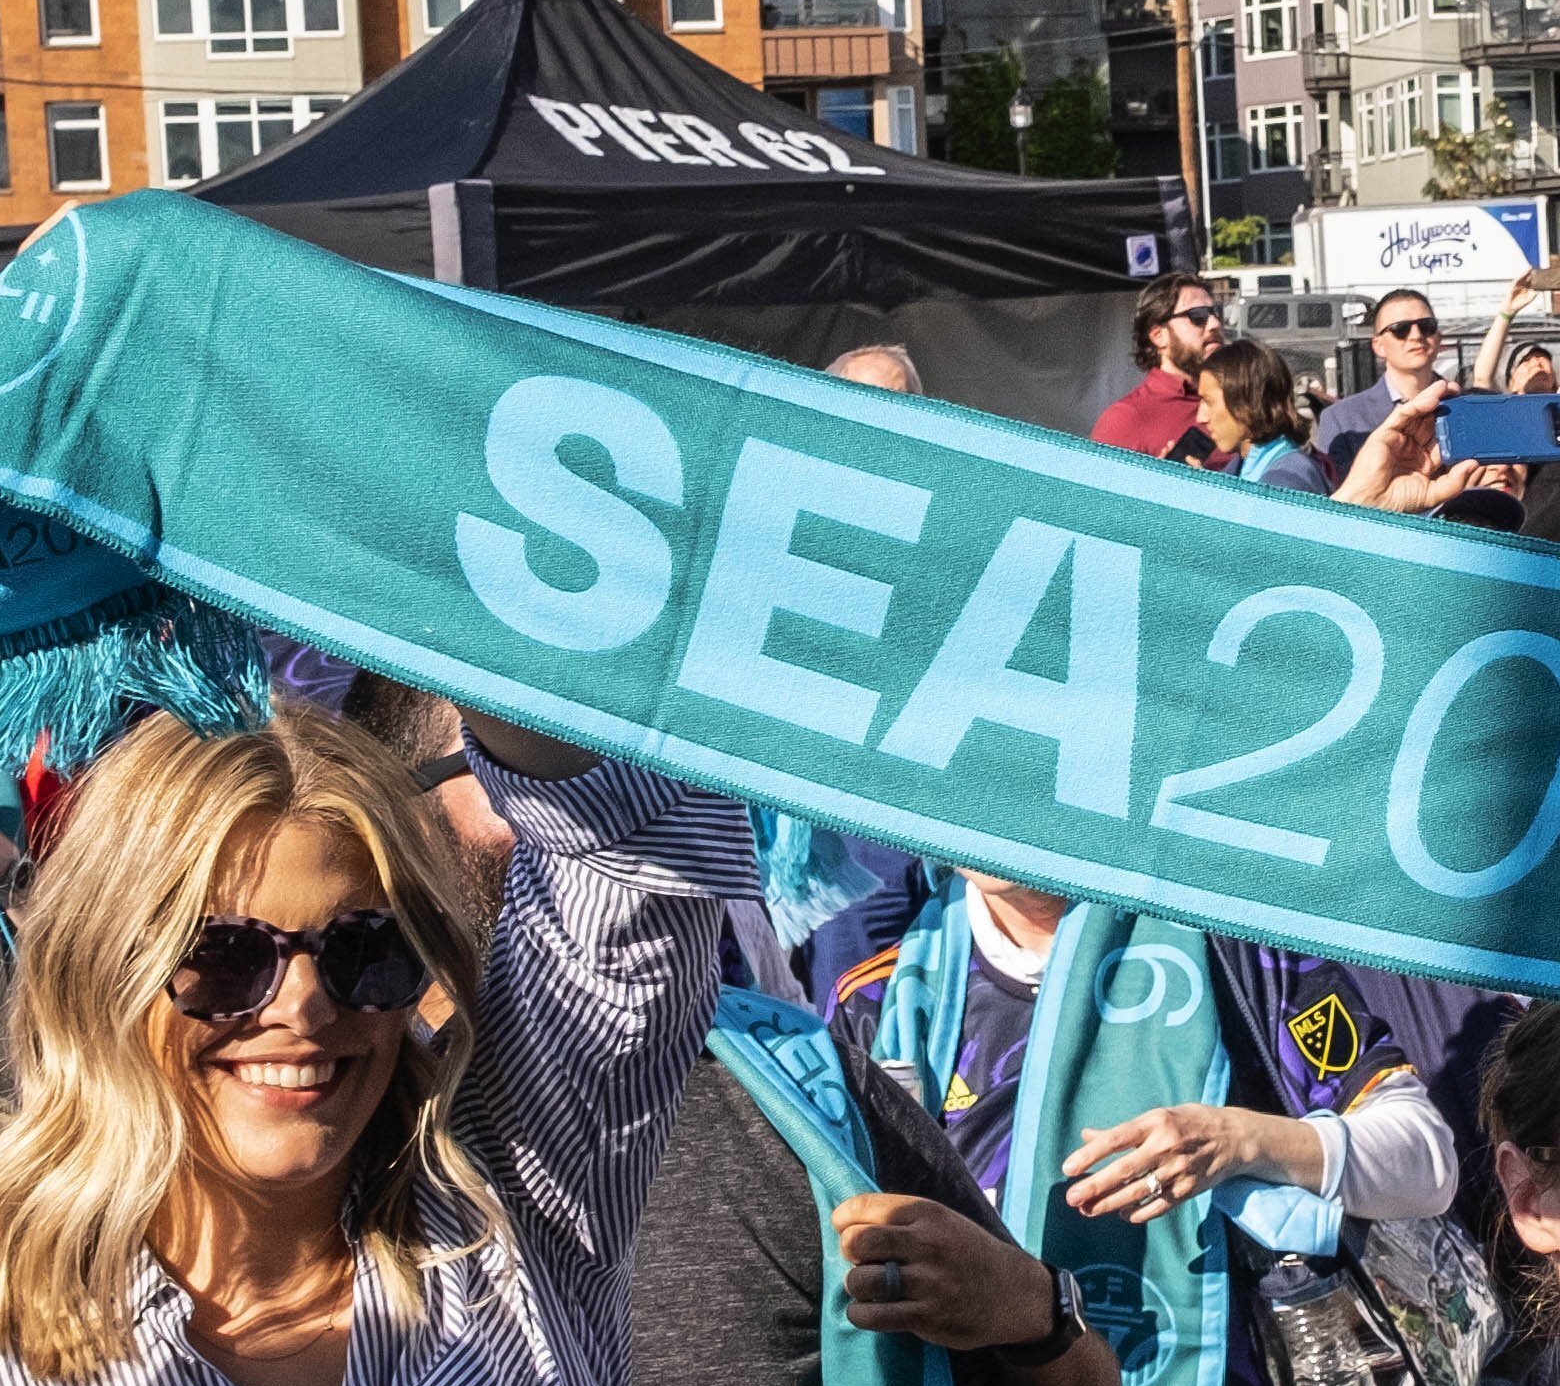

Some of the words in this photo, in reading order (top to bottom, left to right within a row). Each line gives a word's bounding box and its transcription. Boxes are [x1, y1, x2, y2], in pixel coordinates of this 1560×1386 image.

[526, 93, 771, 171] PIER
[737, 121, 887, 176] 62
[1379, 218, 1471, 269] Hollywood
[1408, 252, 1464, 273] LIGHTS
[1295, 1010, 1328, 1041] MLS
